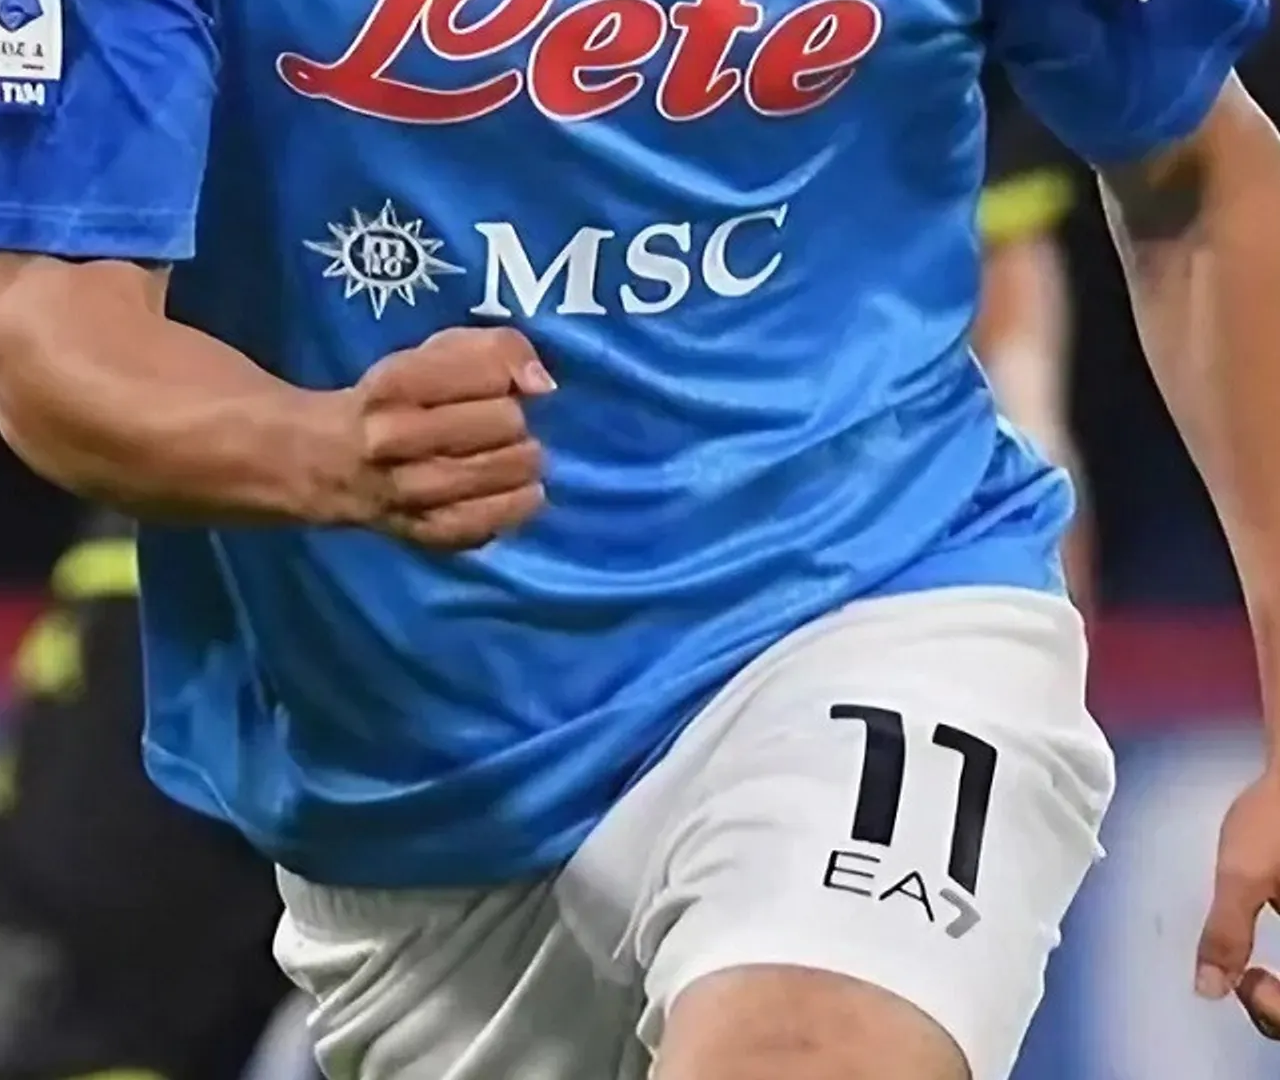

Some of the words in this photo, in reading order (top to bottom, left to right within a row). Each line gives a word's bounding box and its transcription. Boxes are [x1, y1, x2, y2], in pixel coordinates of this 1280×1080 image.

[470, 202, 788, 318] MSC
[829, 703, 998, 898] 11
[822, 849, 982, 939] EA7
